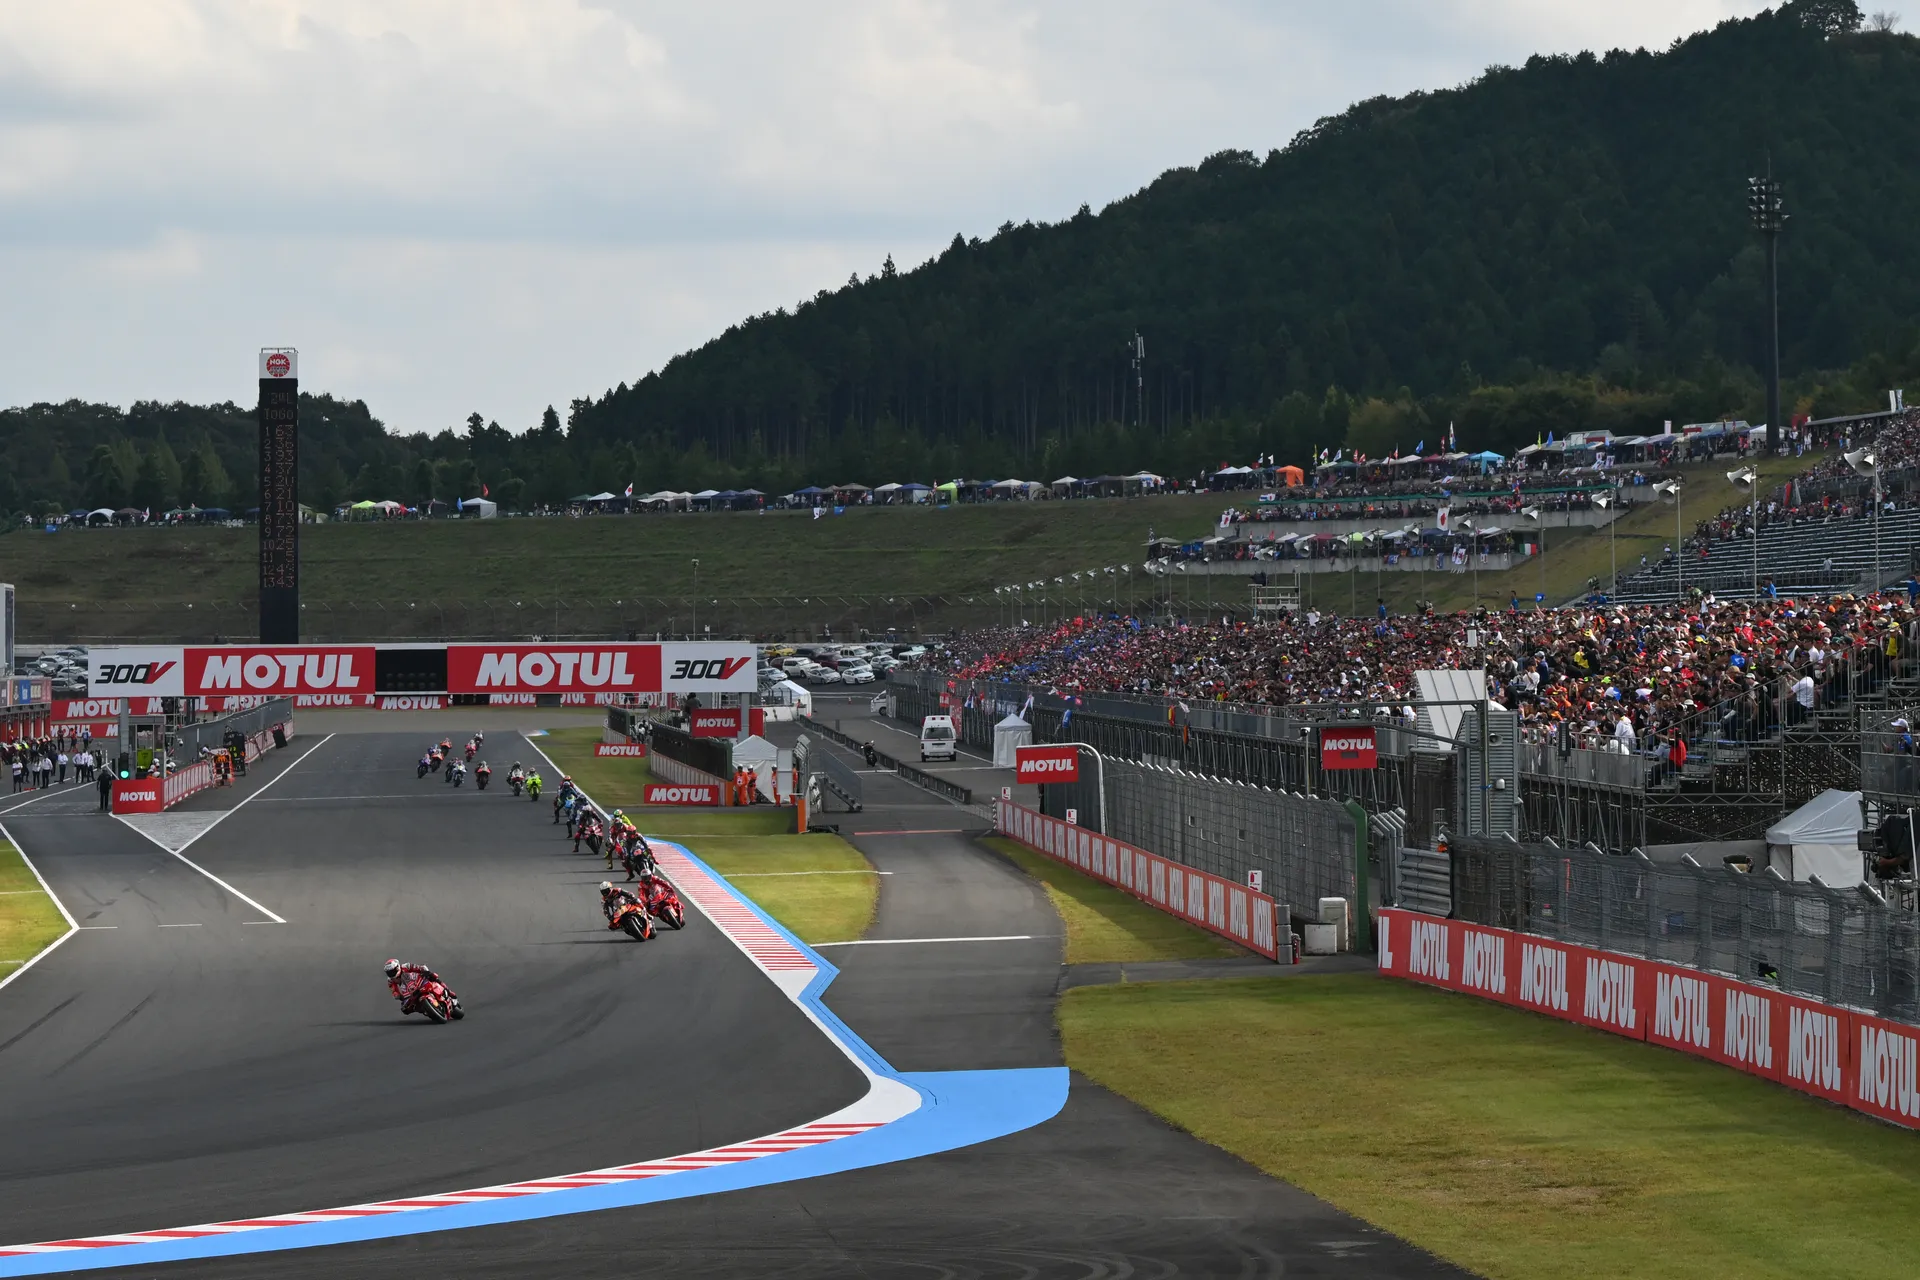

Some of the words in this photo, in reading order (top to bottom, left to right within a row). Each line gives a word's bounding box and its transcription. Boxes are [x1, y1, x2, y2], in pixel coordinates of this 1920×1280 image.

[265, 426, 270, 436] 1
[263, 438, 271, 449] 2
[263, 451, 271, 461] 3
[264, 463, 271, 473] 4
[263, 476, 271, 487] 5
[264, 489, 272, 500] 6
[275, 487, 291, 500] 21
[263, 501, 272, 512] 7
[277, 500, 294, 512] 10
[264, 514, 272, 525] 8
[264, 527, 272, 537] 9
[262, 539, 275, 550] 10
[262, 551, 273, 563] 11
[263, 577, 275, 588] 13
[94, 661, 178, 685] 300V
[199, 653, 361, 689] MOTUL
[475, 651, 635, 687] MOTUL
[669, 656, 752, 680] 300V
[297, 694, 353, 706] MOTUL
[381, 696, 442, 710] MOTUL
[489, 693, 536, 704] MOTUL
[66, 698, 131, 718] MOTU
[696, 718, 736, 728] MOTUL
[598, 745, 642, 757] MOTUL
[1323, 738, 1375, 751] MOTUL
[1020, 759, 1075, 773] MOTUL
[119, 791, 157, 802] MOTUL
[649, 787, 713, 802] MOTUL
[1409, 919, 1450, 981] MOTUL
[1461, 929, 1507, 995] MOTUL
[1519, 942, 1569, 1012] MOTUL
[1583, 956, 1637, 1030] MOTUL
[1654, 971, 1711, 1049] MOTUL
[1723, 988, 1773, 1070] MOTUL
[1788, 1005, 1842, 1092] MOTUL
[1858, 1024, 1920, 1120] MOTUL
